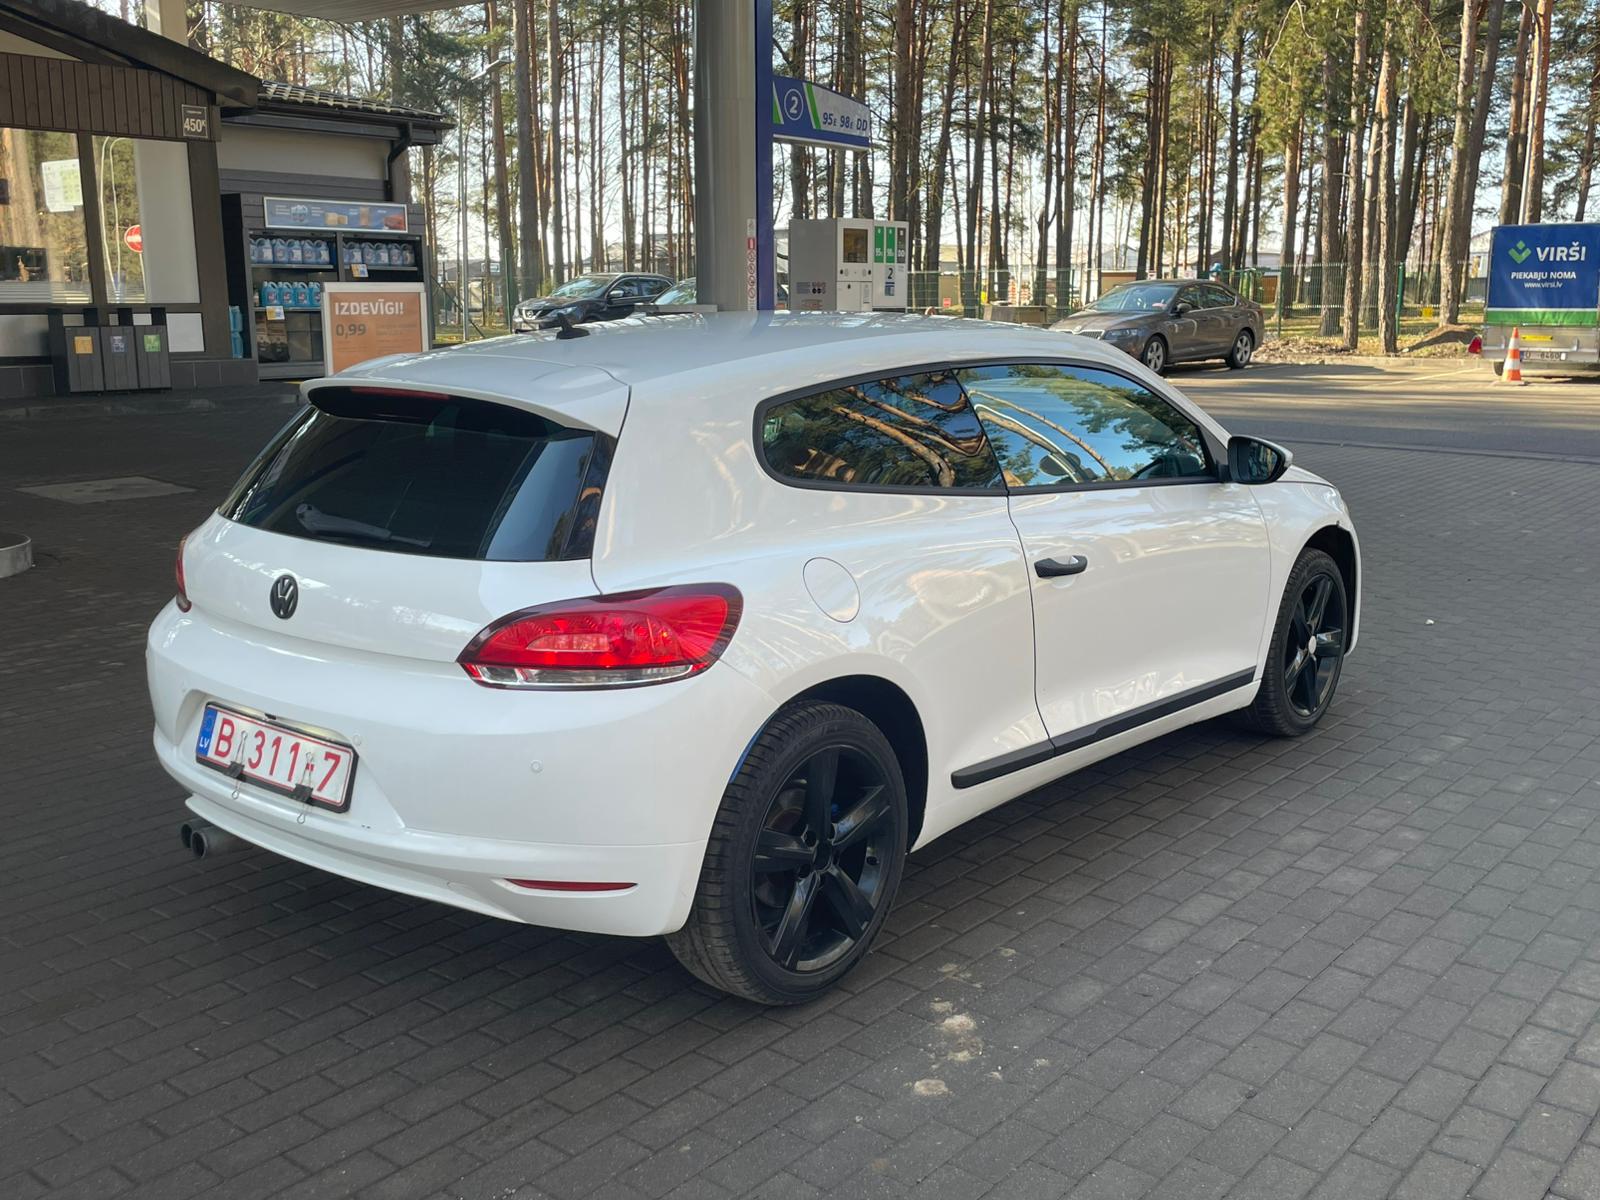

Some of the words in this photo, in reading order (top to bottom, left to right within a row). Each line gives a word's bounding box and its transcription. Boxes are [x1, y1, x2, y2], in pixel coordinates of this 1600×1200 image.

[789, 96, 799, 114] 2
[856, 118, 869, 131] DD
[1536, 241, 1587, 262] VIRŠI
[887, 267, 894, 280] 2
[1549, 271, 1577, 280] NOMA
[335, 298, 404, 315] IZDEVĪGI!
[335, 323, 367, 339] 0,99
[199, 736, 210, 747] LV
